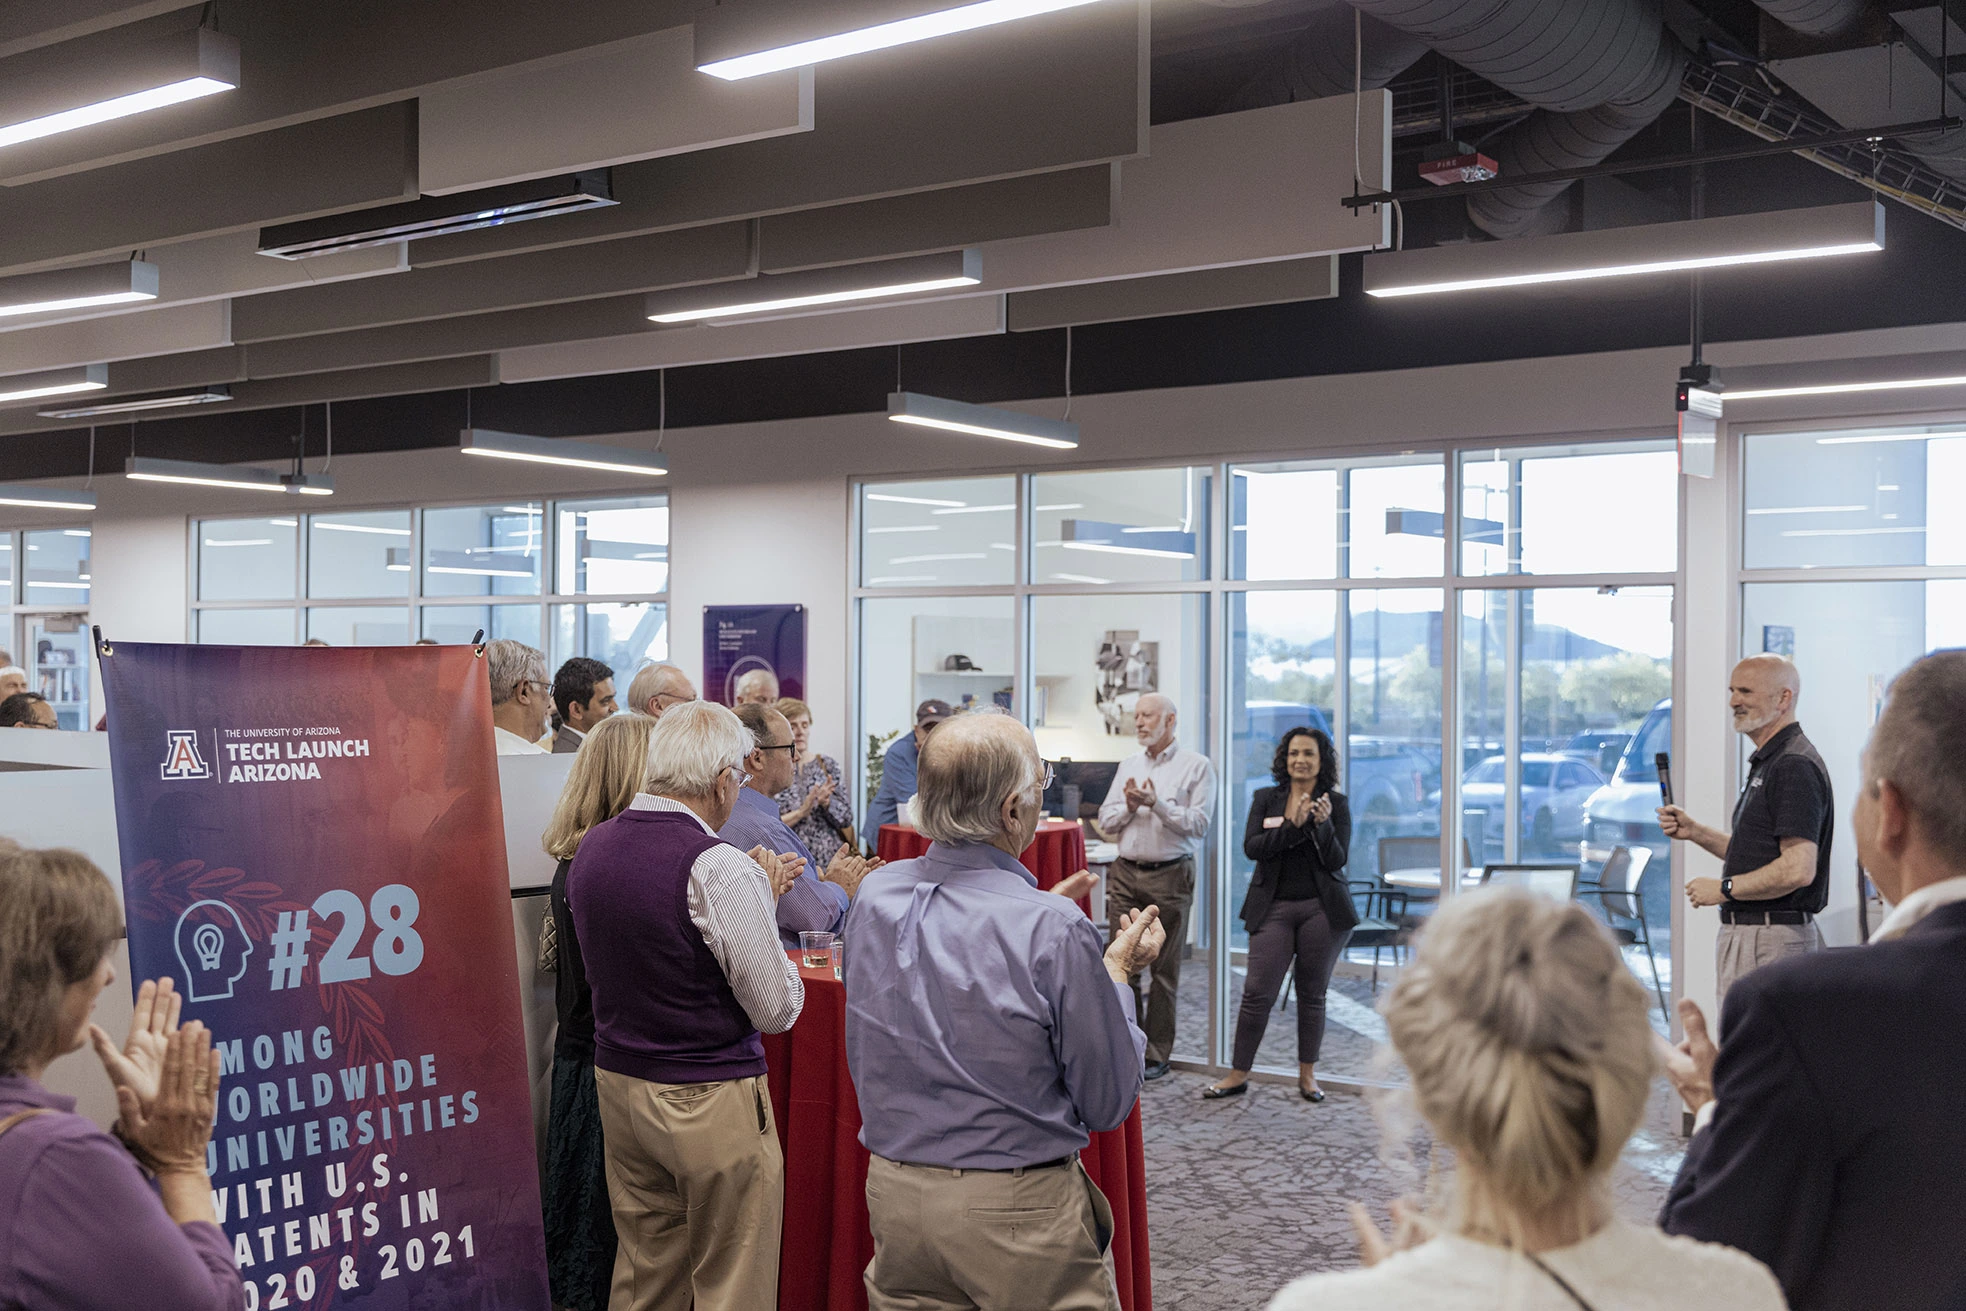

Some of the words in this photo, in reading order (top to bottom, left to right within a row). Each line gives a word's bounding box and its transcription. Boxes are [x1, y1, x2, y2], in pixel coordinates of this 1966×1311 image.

[224, 729, 241, 738] THE
[243, 728, 291, 738] UNIVERSITY
[292, 727, 303, 737] OF
[305, 726, 341, 736] ARIZONA
[226, 742, 280, 761] TECH
[286, 739, 370, 759] LAUNCH
[228, 762, 322, 783] ARIZONA
[268, 883, 425, 991] #28
[216, 1025, 333, 1076] MONG
[212, 1054, 437, 1126] ORLDWIDE
[325, 1153, 408, 1198] U.S.
[234, 1201, 380, 1270] ATENTS
[400, 1187, 439, 1228] IN
[243, 1265, 316, 1311] 020
[338, 1255, 361, 1291] &
[377, 1224, 474, 1280] 2021
